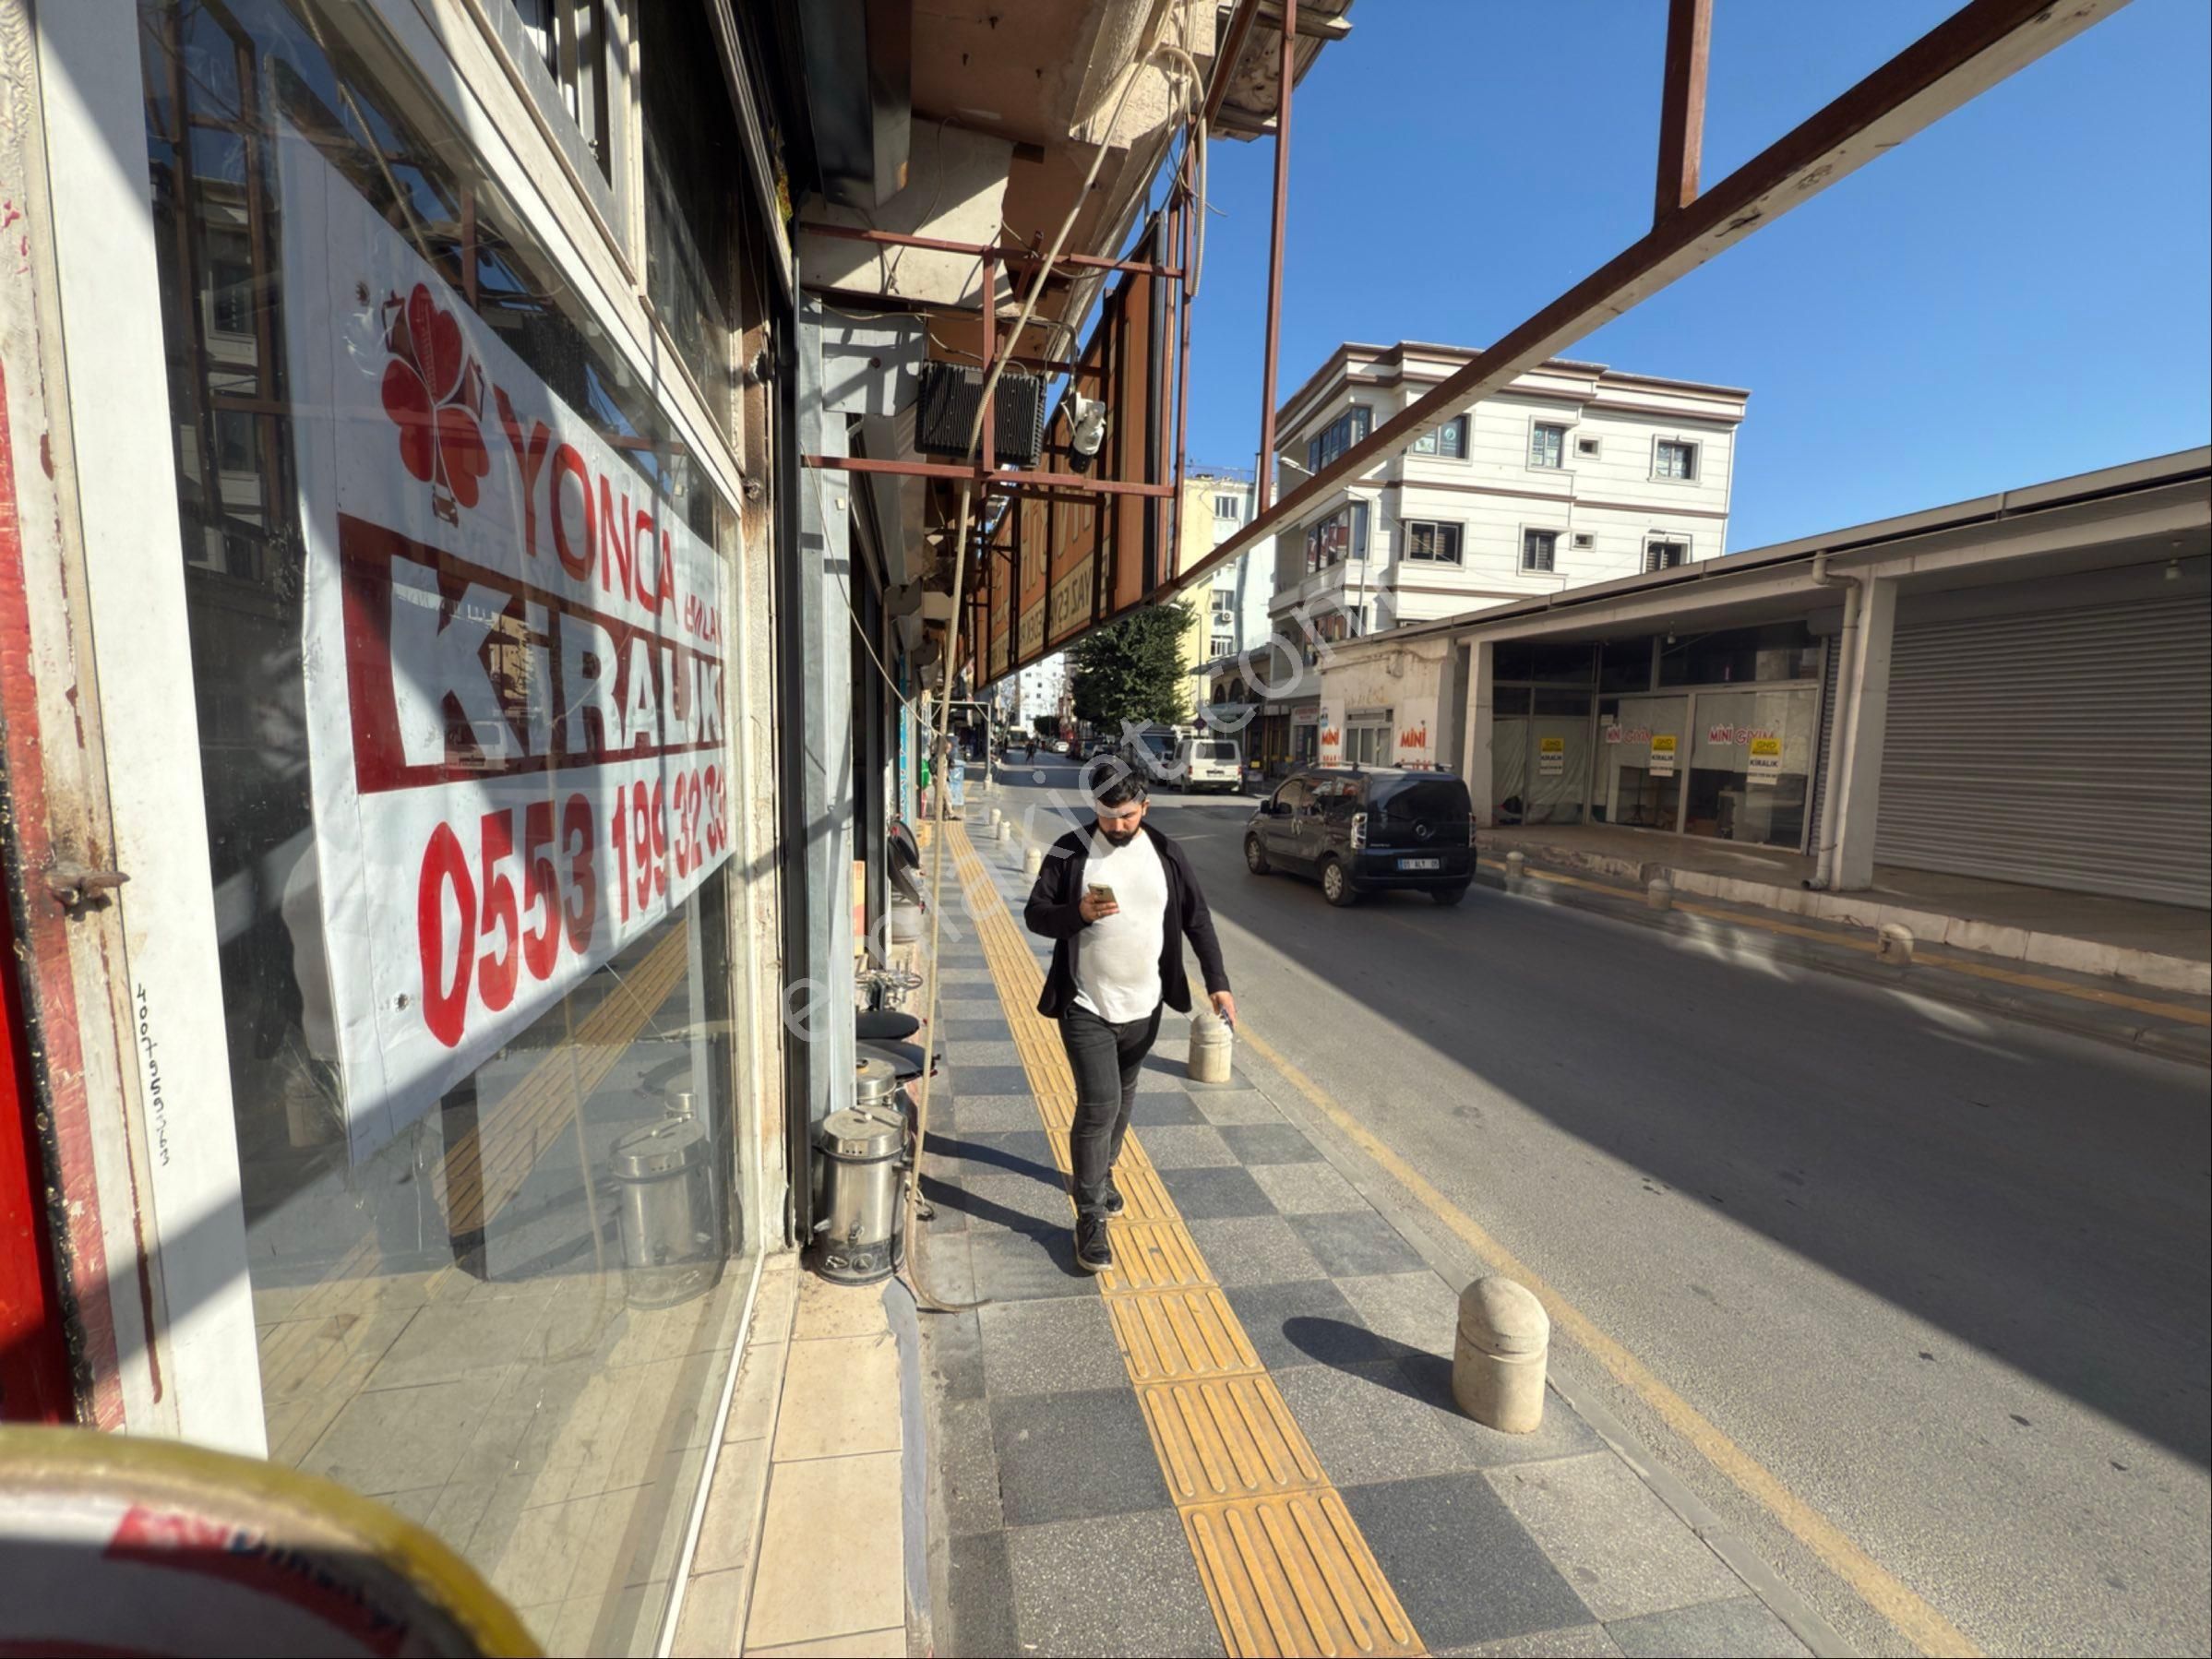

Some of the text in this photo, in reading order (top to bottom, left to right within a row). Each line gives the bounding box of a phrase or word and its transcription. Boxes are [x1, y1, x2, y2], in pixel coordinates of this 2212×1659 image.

[493, 383, 678, 625] YONCA
[417, 793, 596, 1048] 0553
[612, 776, 667, 924] 199
